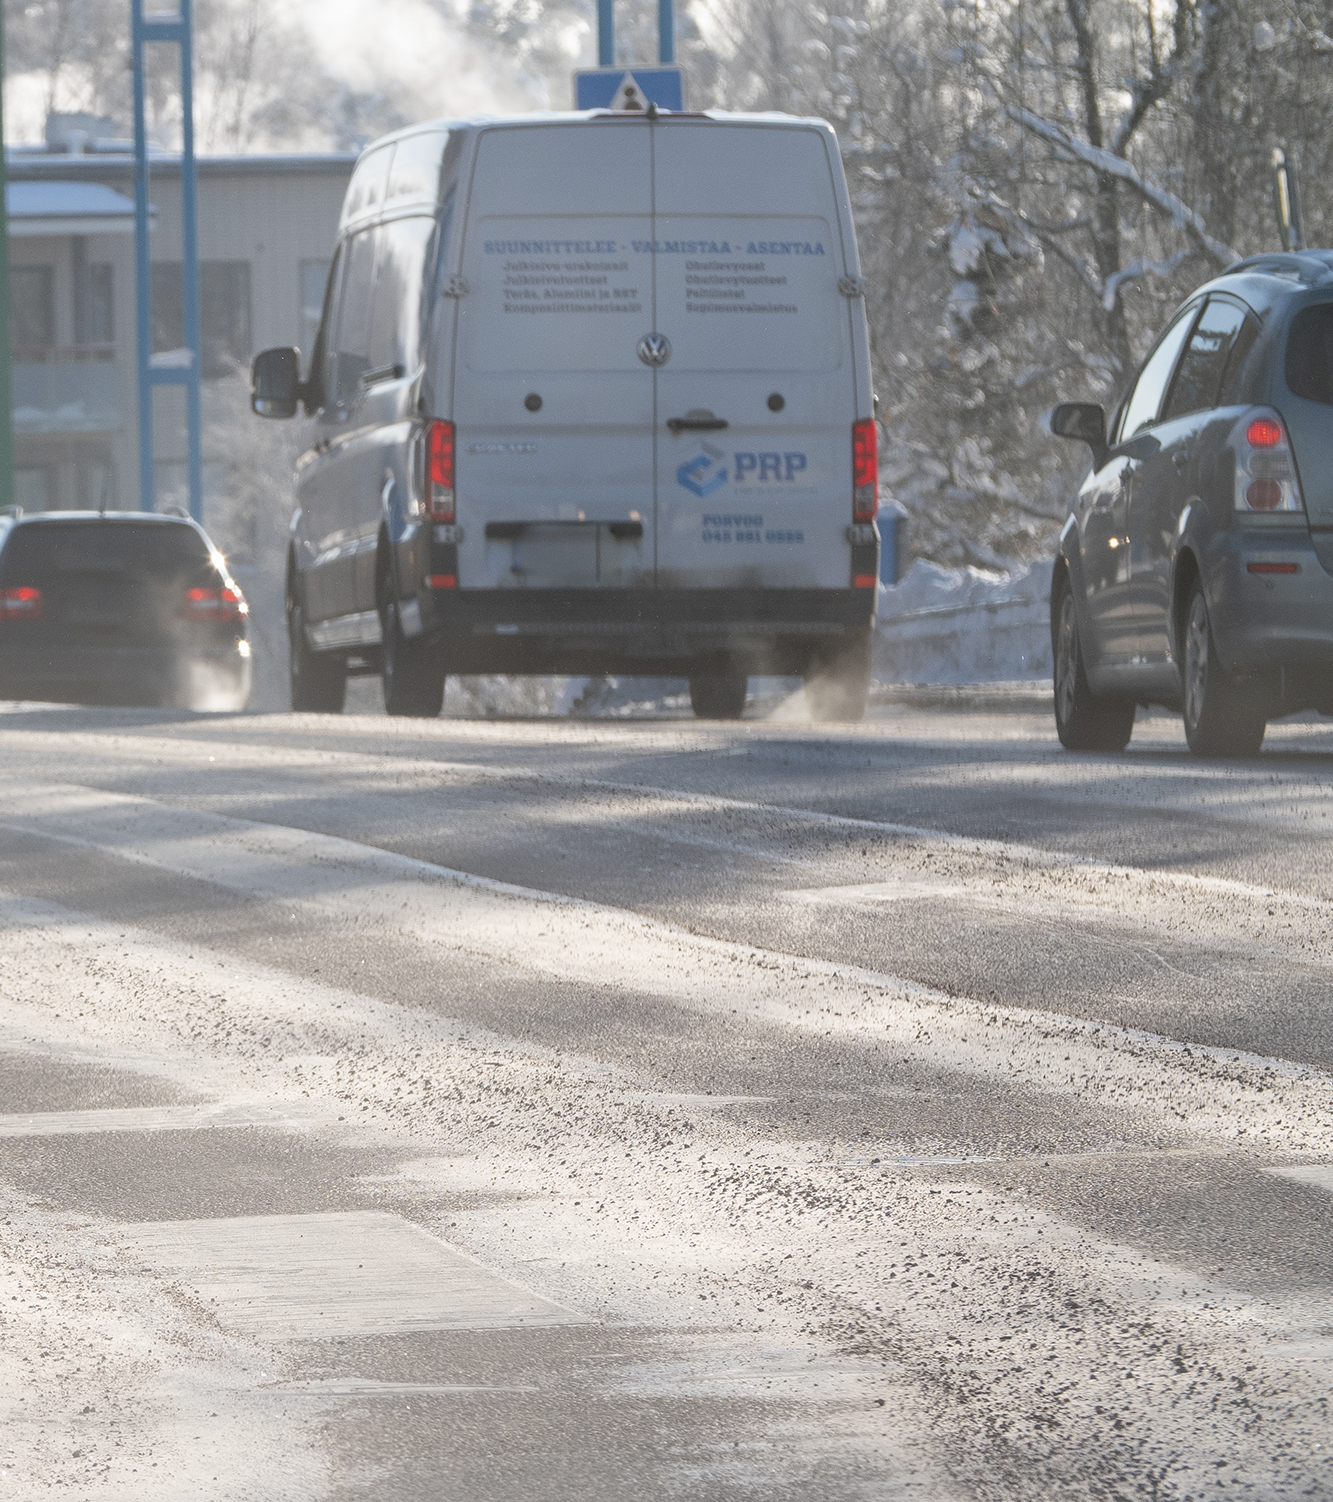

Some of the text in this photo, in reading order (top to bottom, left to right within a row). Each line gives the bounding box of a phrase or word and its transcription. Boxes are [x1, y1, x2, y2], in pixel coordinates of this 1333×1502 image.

[484, 240, 617, 255] SUUNNITTELEE
[630, 240, 732, 255] VALMISTAA
[747, 241, 826, 256] ASENTAA
[734, 451, 808, 482] PRP
